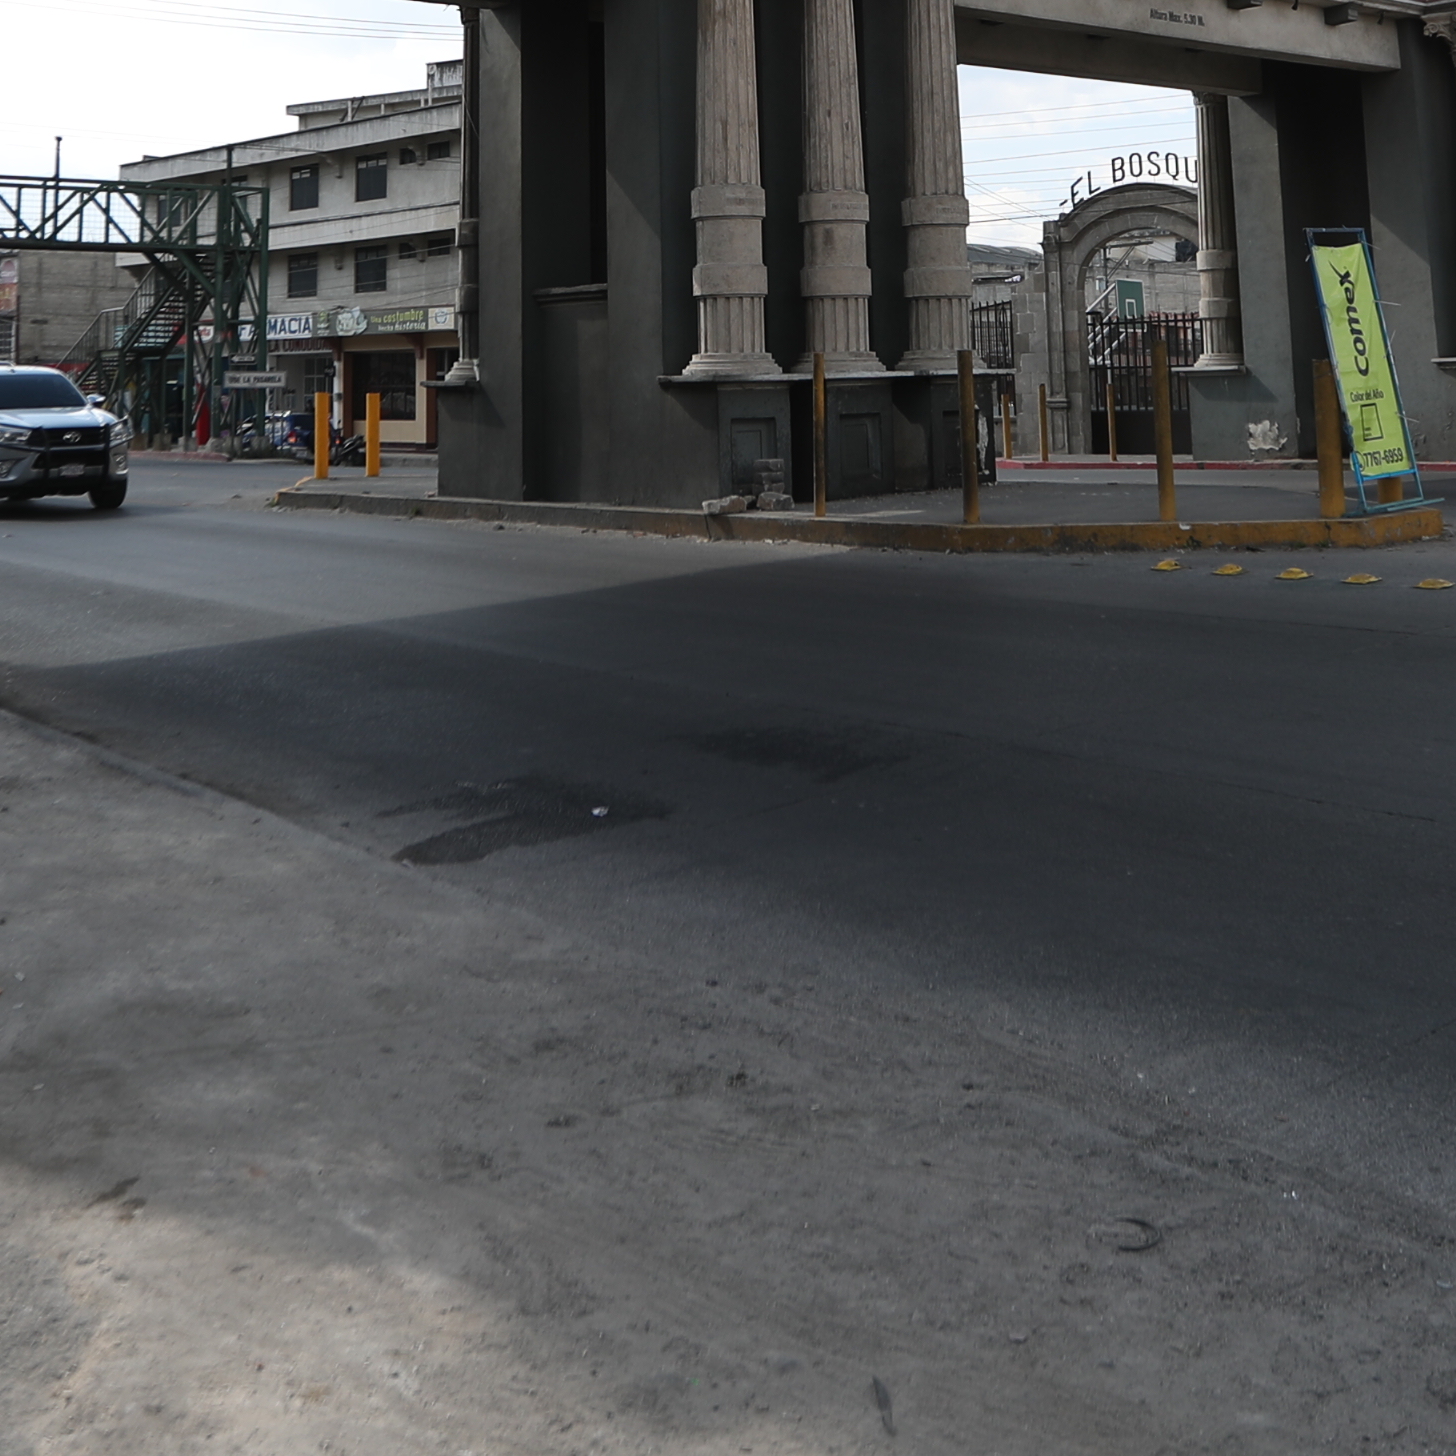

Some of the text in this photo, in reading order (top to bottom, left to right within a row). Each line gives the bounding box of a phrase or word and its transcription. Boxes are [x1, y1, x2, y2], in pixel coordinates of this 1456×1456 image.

[1150, 8, 1168, 21] Altura
[383, 309, 424, 323] costumbre
[394, 321, 426, 332] historia
[1350, 391, 1365, 402] Color
[1372, 388, 1384, 399] Año
[1364, 447, 1404, 467] 7767-6959
